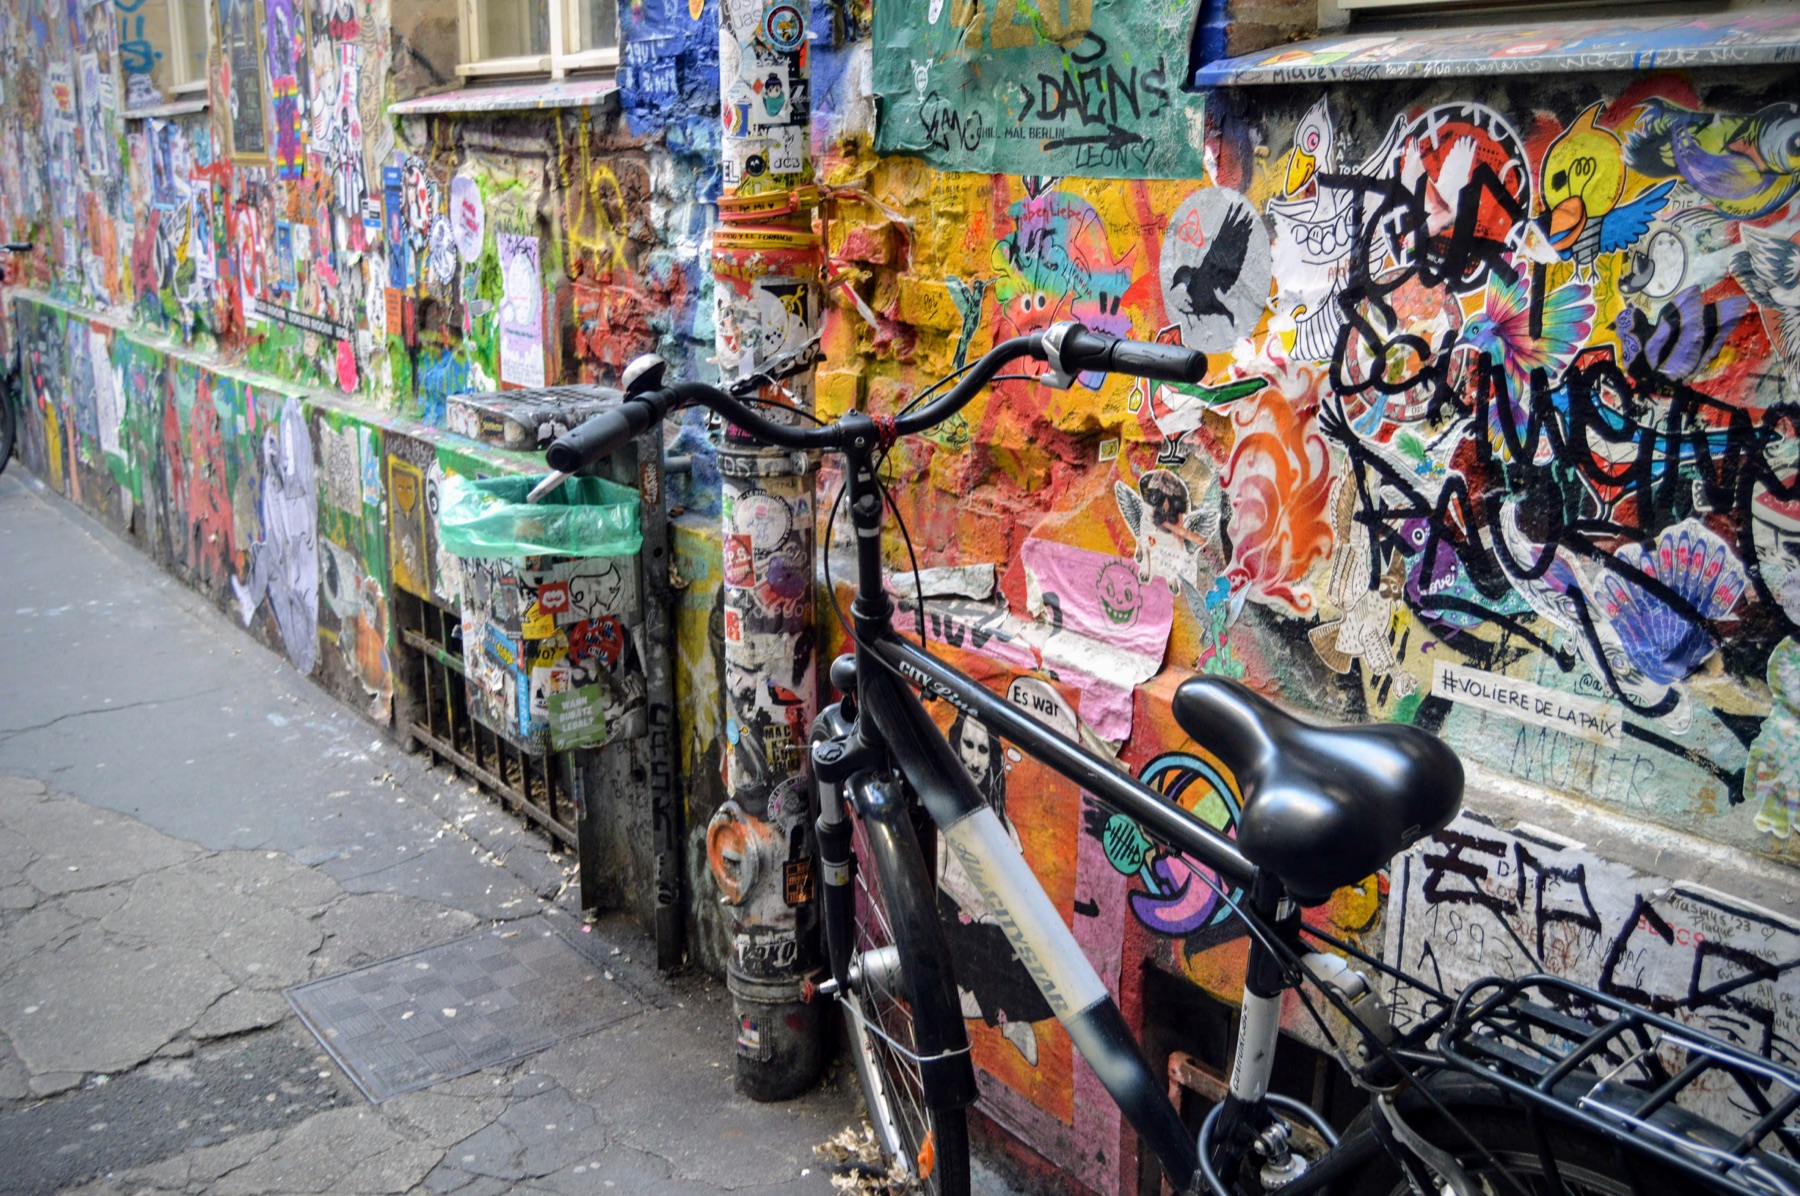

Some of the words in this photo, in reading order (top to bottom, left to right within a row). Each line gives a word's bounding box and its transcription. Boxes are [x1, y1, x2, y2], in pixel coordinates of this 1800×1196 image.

[1004, 127, 1026, 139] MAL
[1029, 127, 1065, 140] BERLIN
[774, 157, 800, 169] JCB
[899, 660, 933, 687] CITY
[1014, 686, 1028, 706] Es
[1032, 695, 1059, 717] war
[1535, 699, 1553, 717] DE
